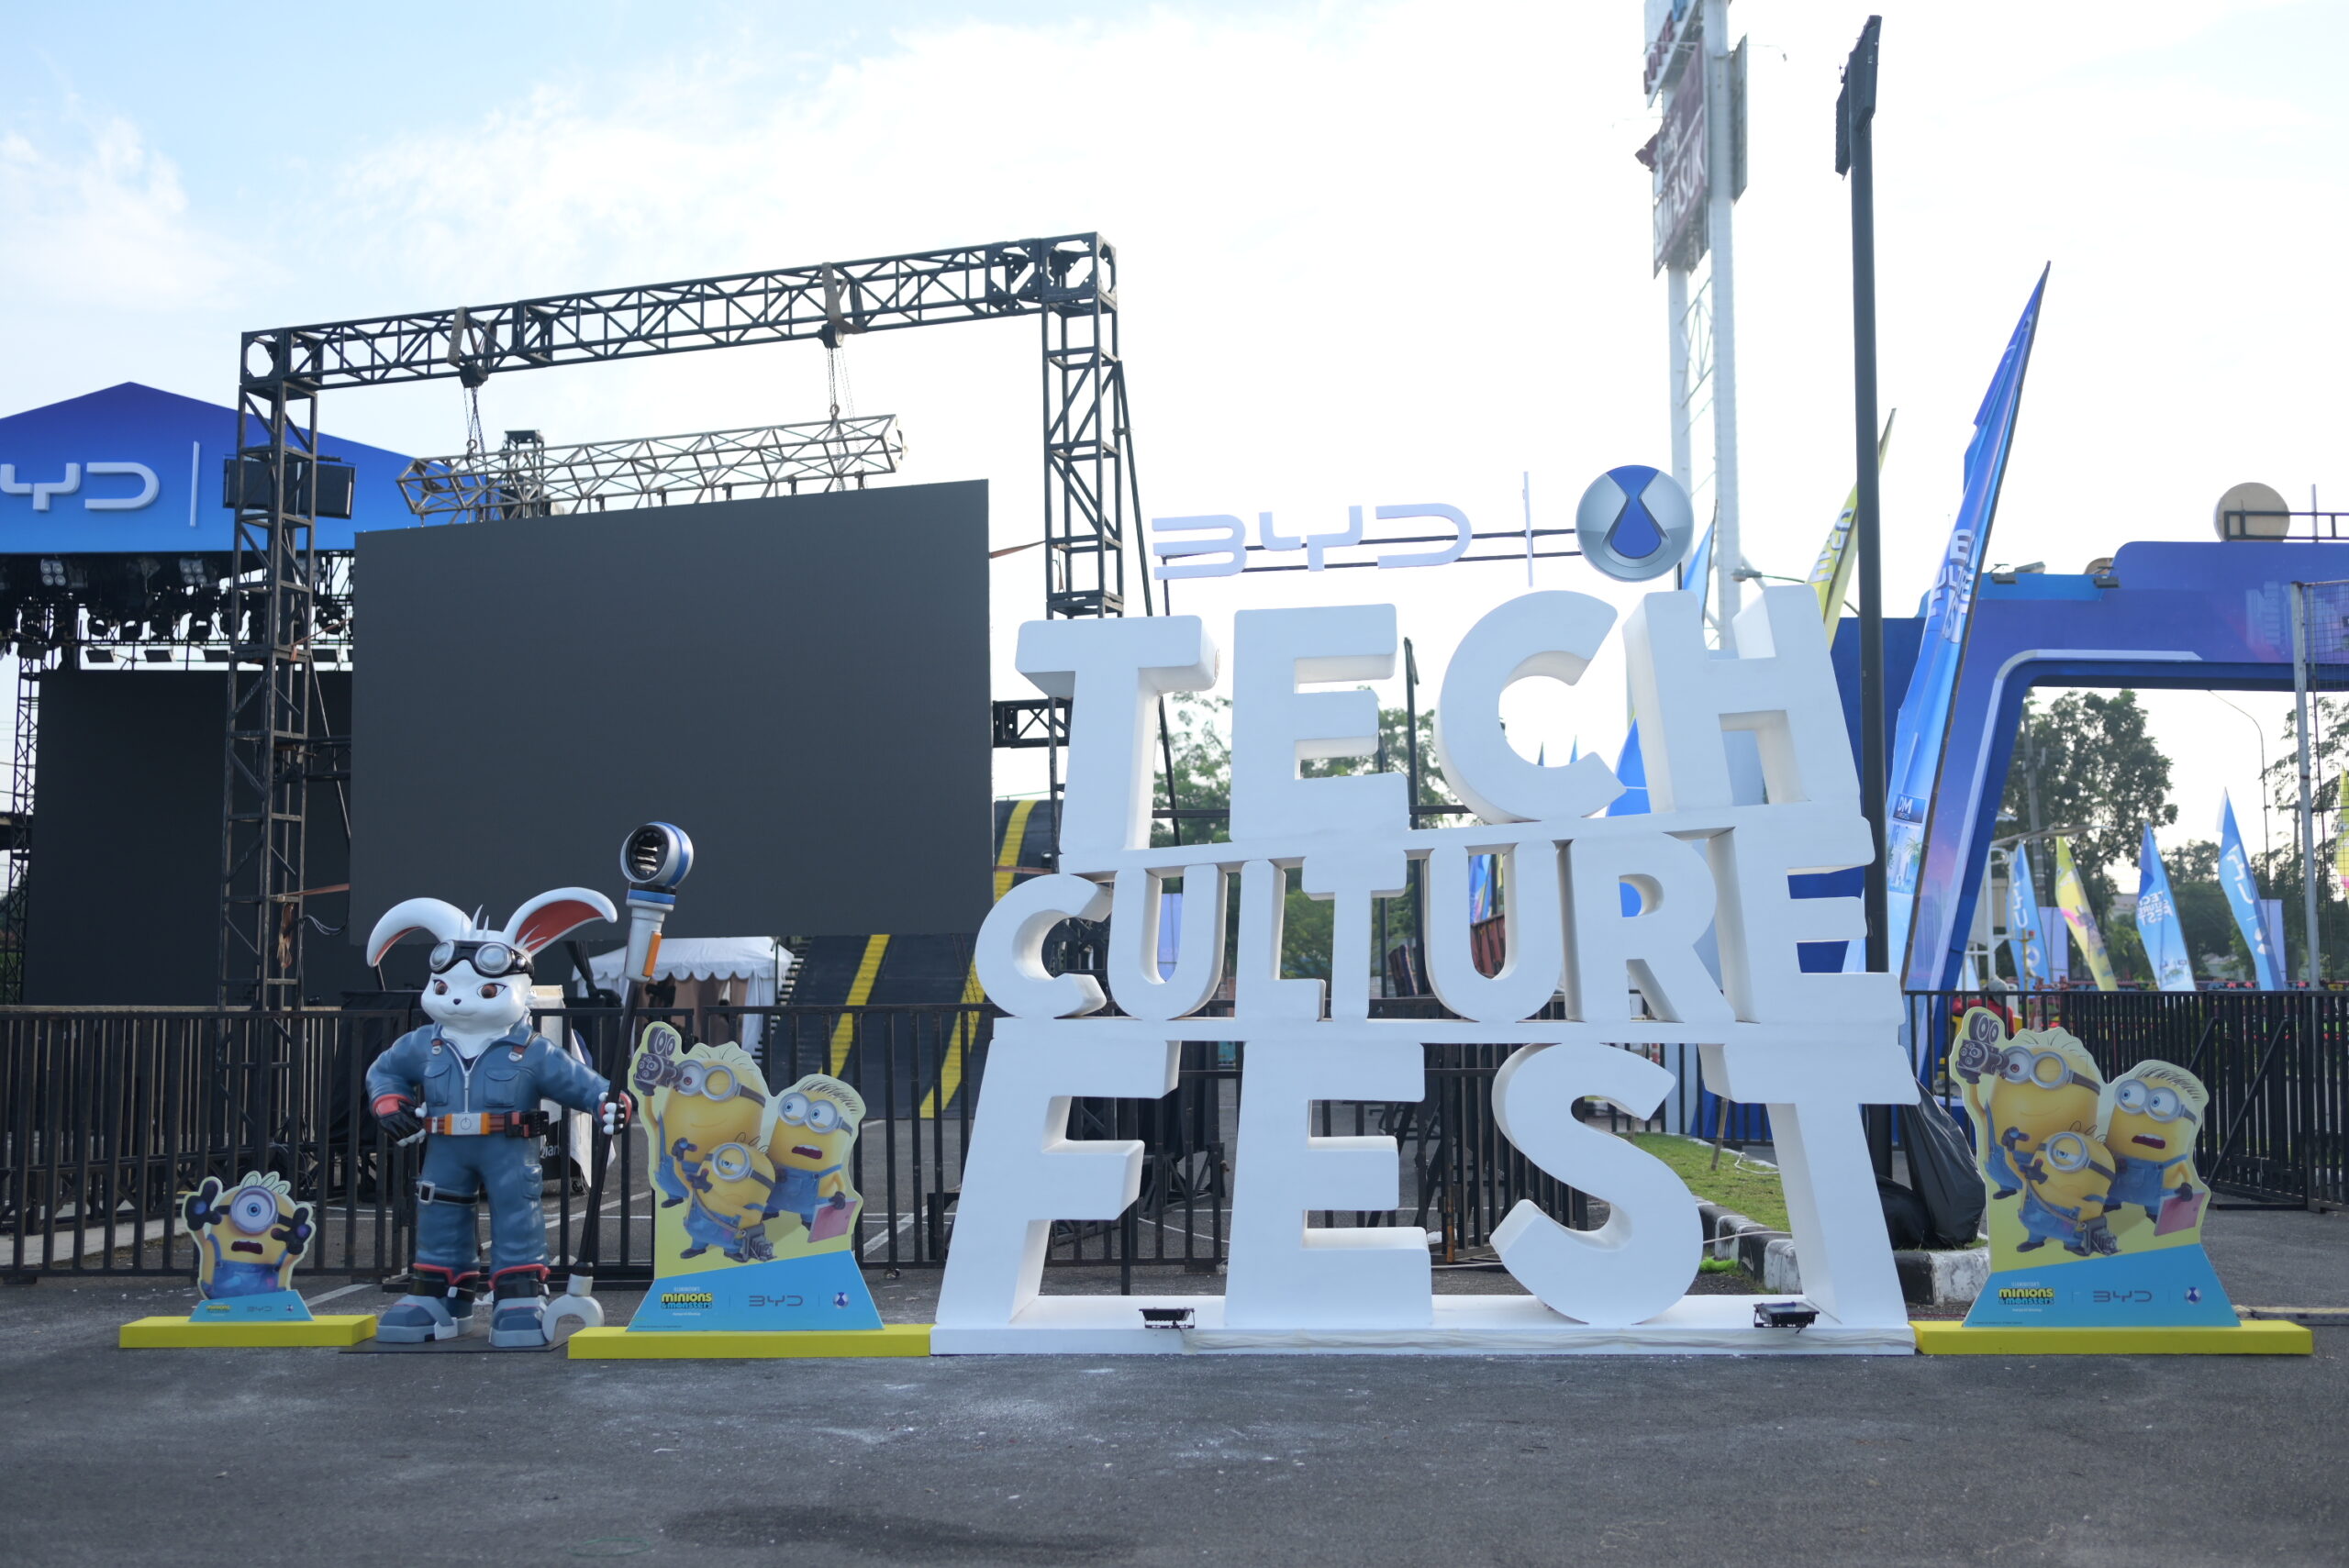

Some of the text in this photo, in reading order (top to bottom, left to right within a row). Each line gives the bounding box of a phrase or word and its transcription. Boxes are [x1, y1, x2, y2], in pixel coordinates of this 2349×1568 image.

[1152, 503, 1472, 580] BYD
[1015, 584, 1862, 853] TECH
[975, 816, 1905, 1025] CULTURE
[935, 1040, 1920, 1325] FEST
[749, 1296, 803, 1307] BYD
[2093, 1290, 2153, 1302] BYD
